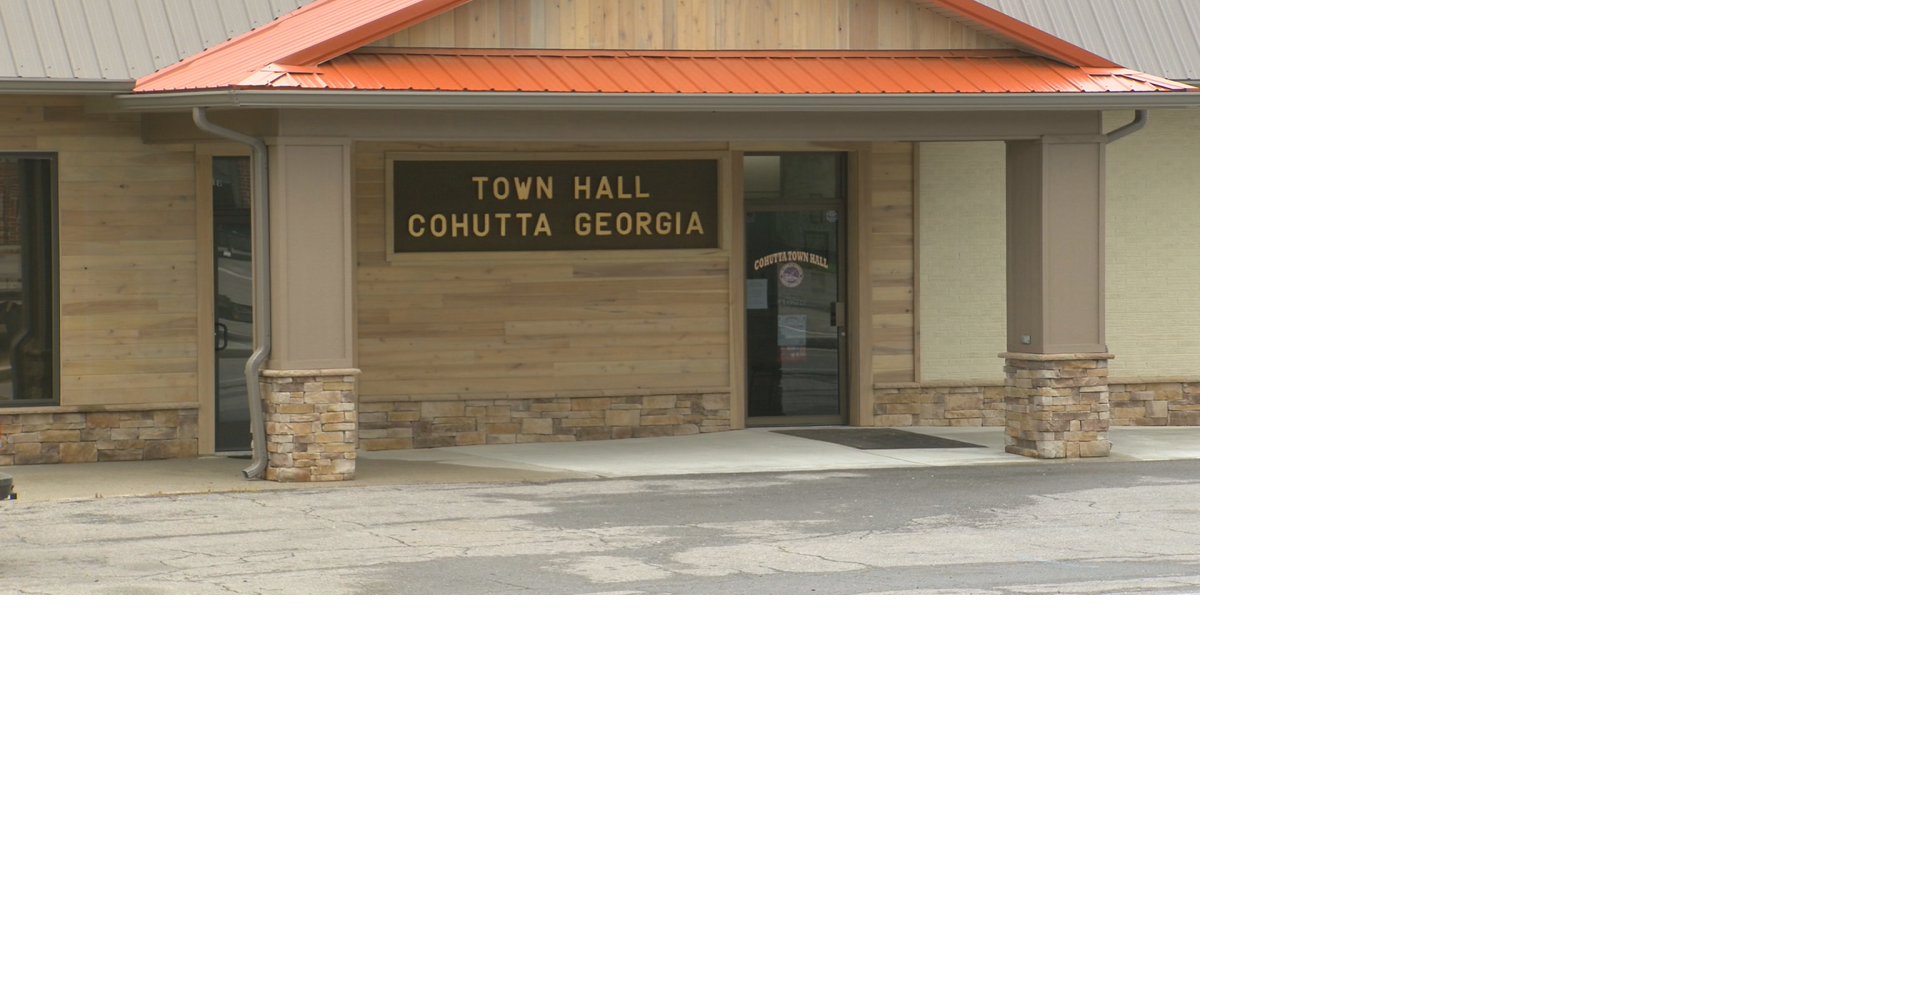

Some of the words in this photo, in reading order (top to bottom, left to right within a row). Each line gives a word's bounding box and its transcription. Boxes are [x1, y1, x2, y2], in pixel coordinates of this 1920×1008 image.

[472, 176, 553, 200] TOWN
[574, 175, 650, 200] HALL
[408, 212, 552, 237] COHUTTA
[574, 211, 704, 236] GEORGIA
[754, 251, 787, 271] COHUTTA
[787, 250, 809, 262] TOWN
[809, 253, 828, 269] HALL
